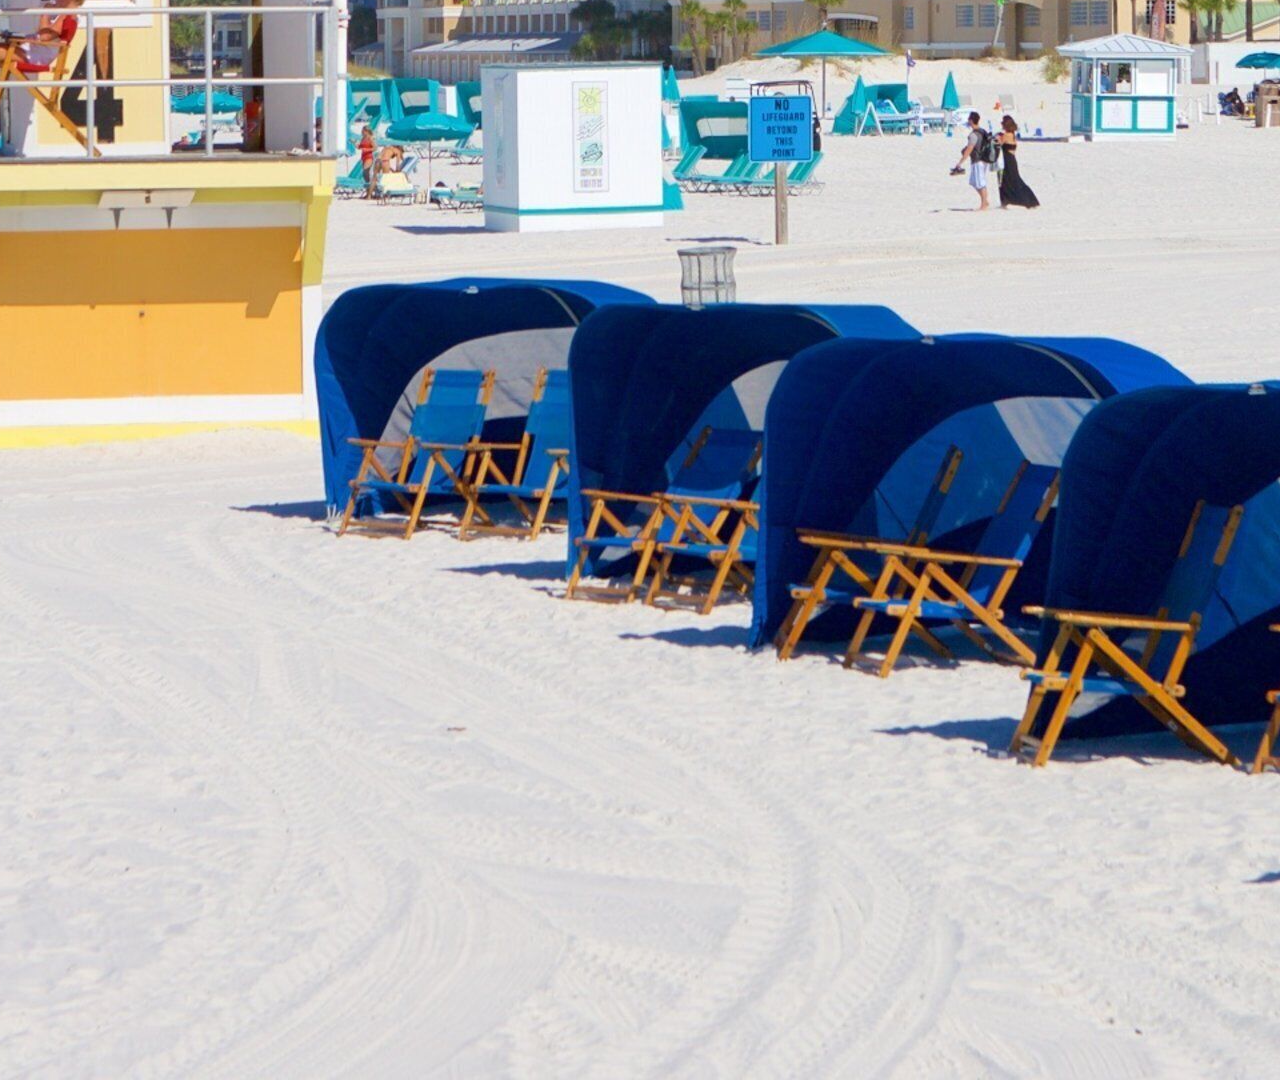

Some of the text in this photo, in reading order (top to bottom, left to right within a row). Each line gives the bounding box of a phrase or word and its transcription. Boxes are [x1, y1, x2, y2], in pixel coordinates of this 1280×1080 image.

[60, 27, 123, 143] 4
[774, 99, 790, 111] NO
[762, 112, 805, 121] LIFEGUARD
[766, 125, 798, 134] BEYOND
[775, 137, 793, 145] THIS
[771, 148, 795, 157] POINT
